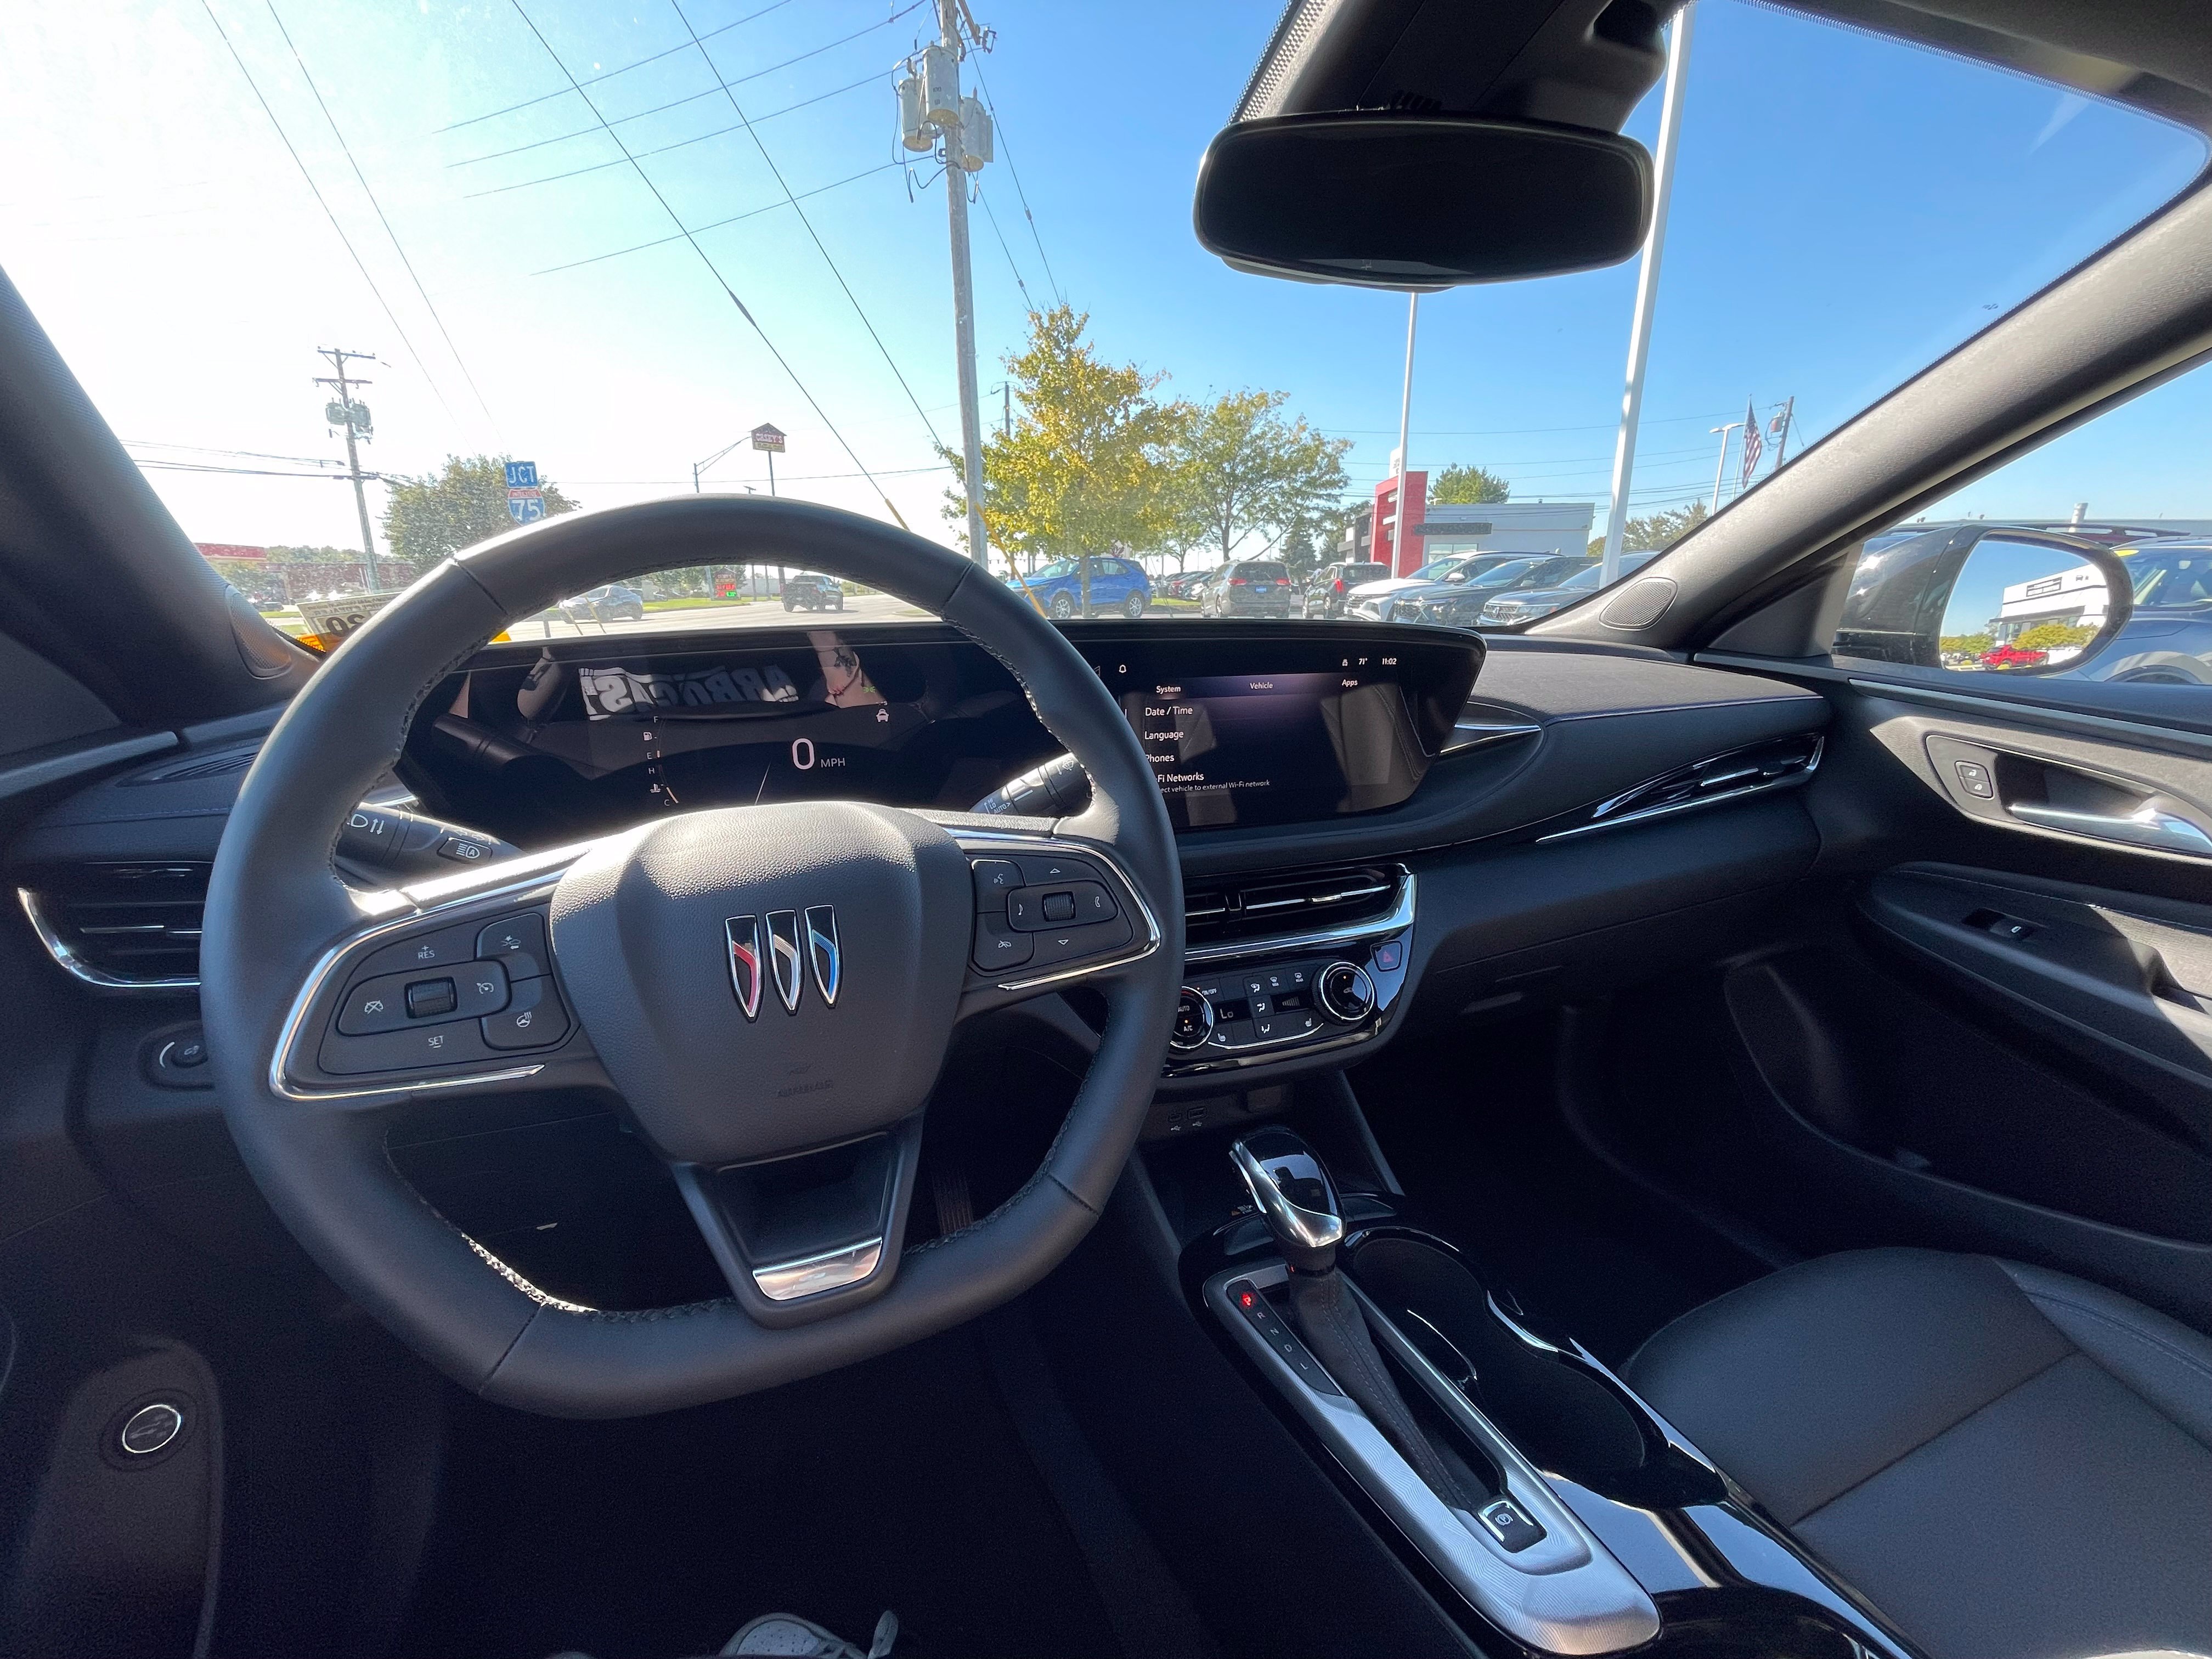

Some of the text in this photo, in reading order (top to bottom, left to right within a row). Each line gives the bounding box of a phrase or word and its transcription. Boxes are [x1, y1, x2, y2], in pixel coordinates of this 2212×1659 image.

[509, 466, 534, 484] JCT
[512, 499, 541, 521] 75
[1250, 681, 1273, 690] Vehicle
[1341, 679, 1358, 687] Apps
[1156, 685, 1181, 695] System
[1144, 707, 1165, 716] Date
[1172, 706, 1193, 715] Time
[1144, 730, 1184, 741] Language
[792, 738, 845, 770] 0 MPH
[1167, 772, 1204, 782] Networks
[1245, 780, 1270, 788] network
[417, 949, 435, 960] RES
[428, 1035, 443, 1046] SET
[1269, 1328, 1279, 1336] N
[1284, 1344, 1293, 1353] D
[1300, 1362, 1308, 1370] L
